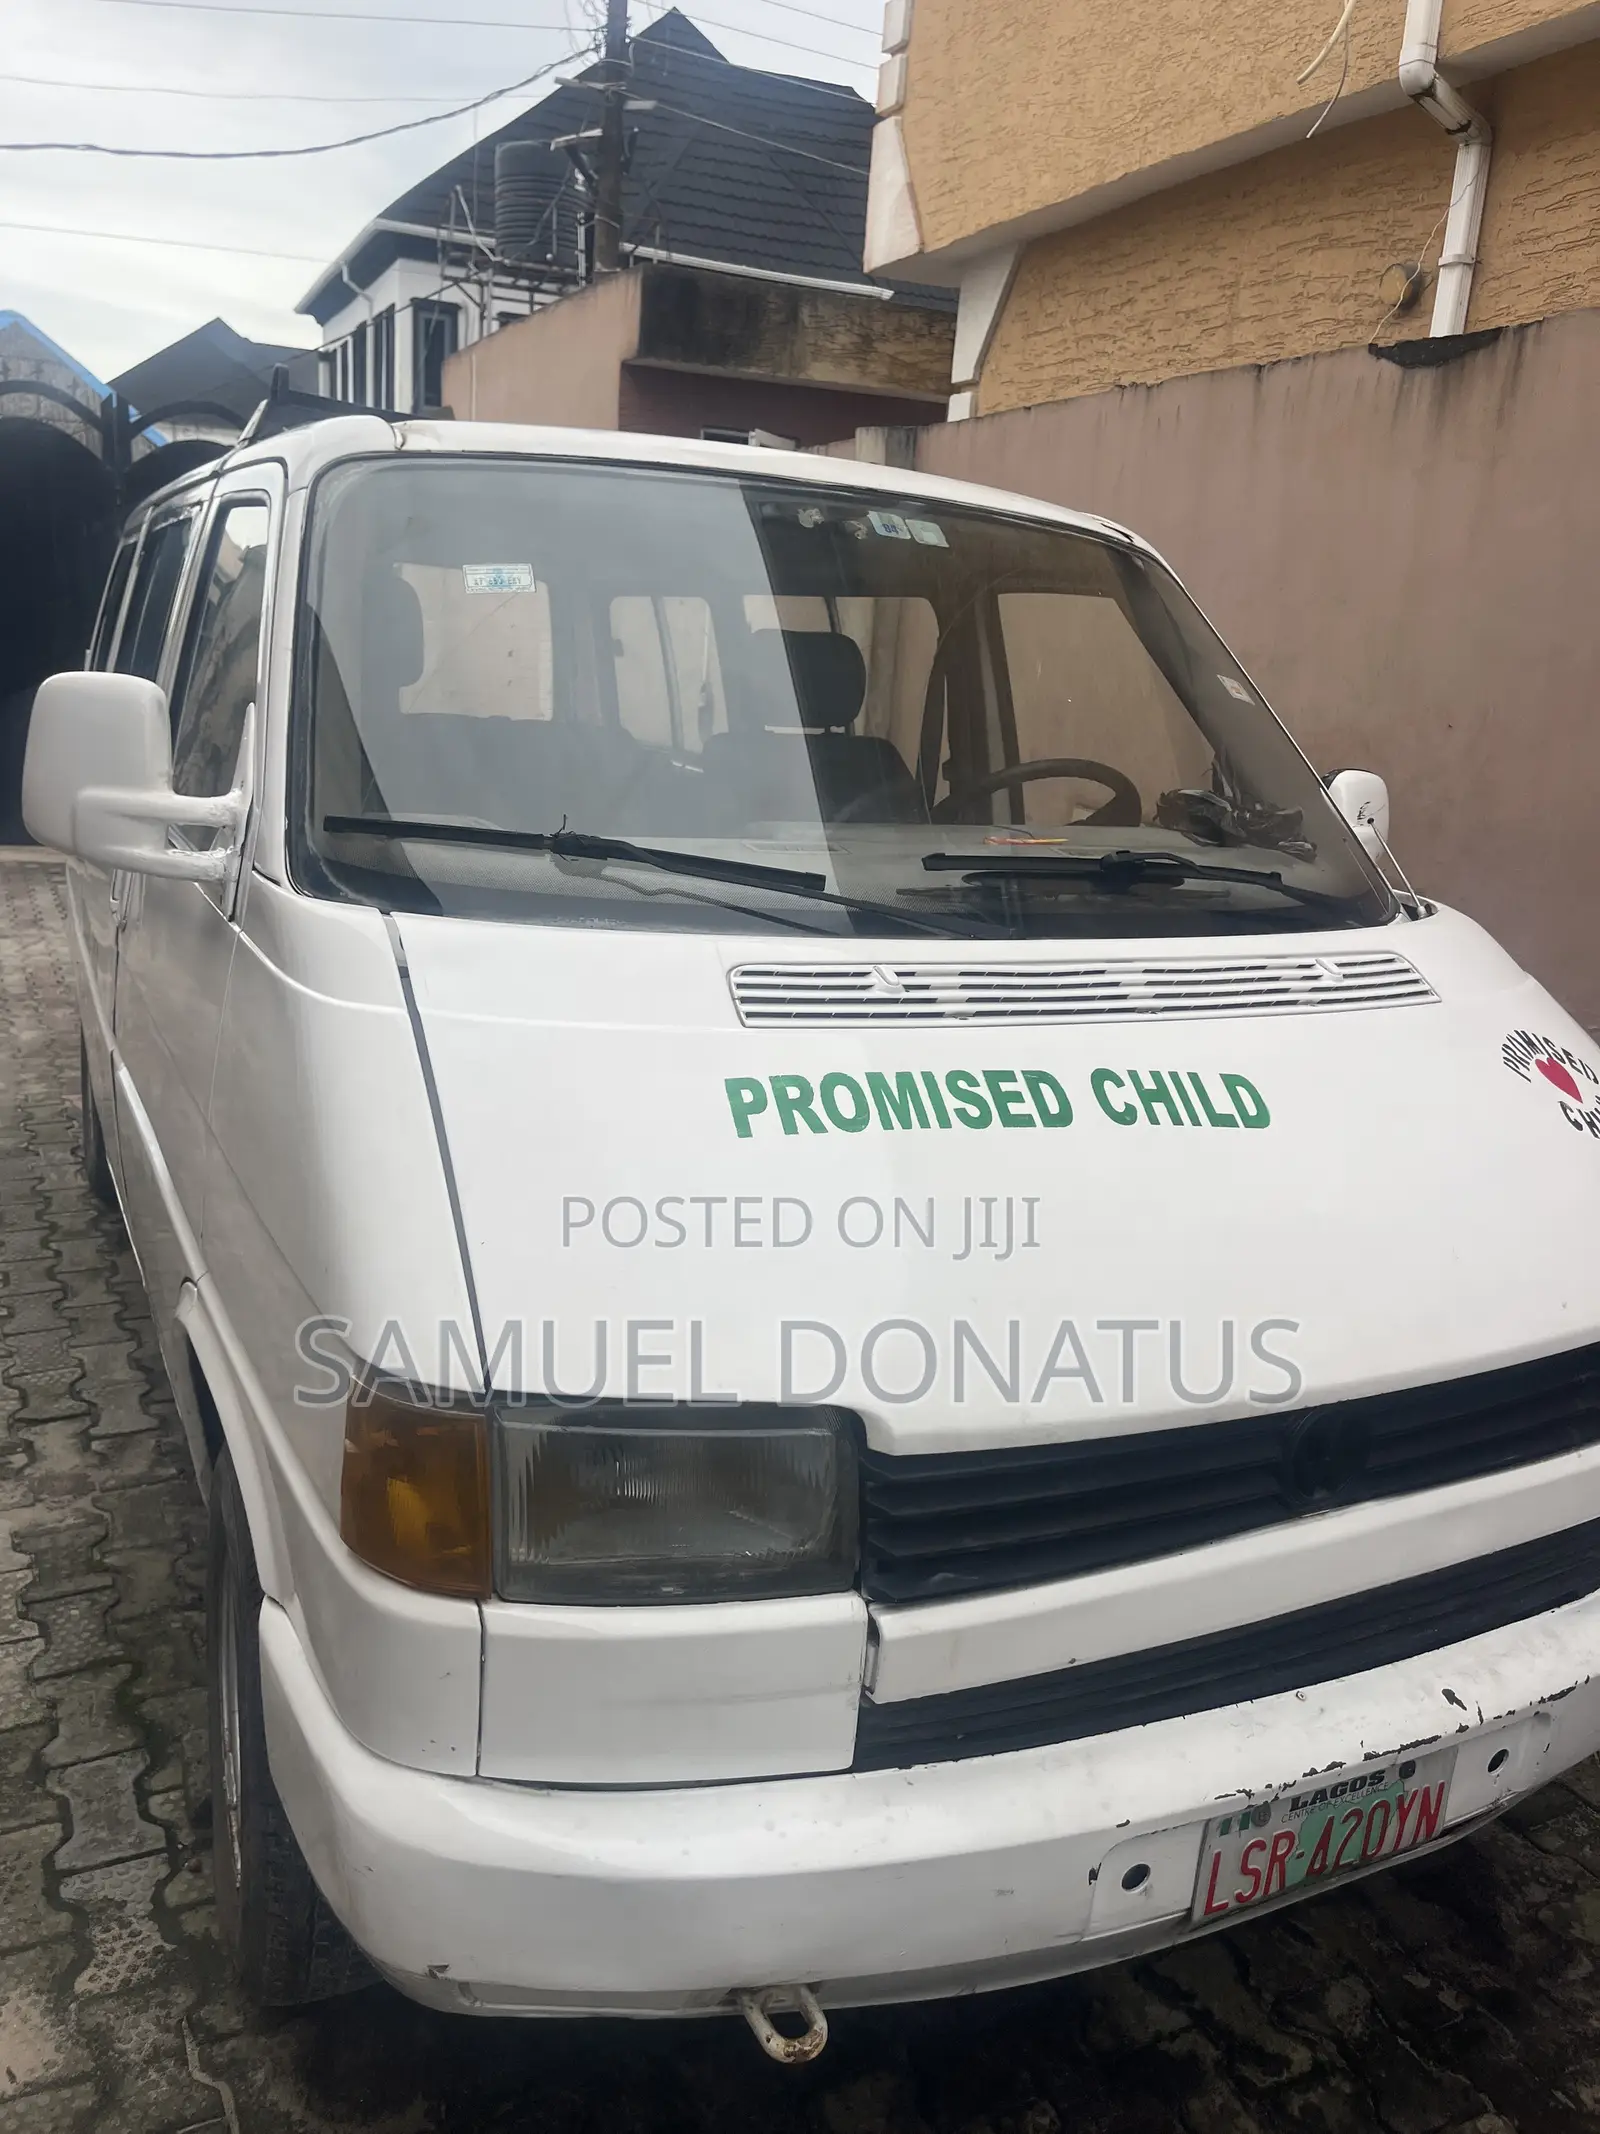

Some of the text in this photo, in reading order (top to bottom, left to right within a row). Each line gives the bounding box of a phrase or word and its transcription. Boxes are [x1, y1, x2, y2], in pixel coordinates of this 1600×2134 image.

[1501, 1029, 1599, 1085] PROMISED
[724, 1067, 1271, 1138] PROMISED CHILD
[1289, 1769, 1386, 1812] LAGOS
[1333, 1781, 1389, 1808] EXCELLENCE
